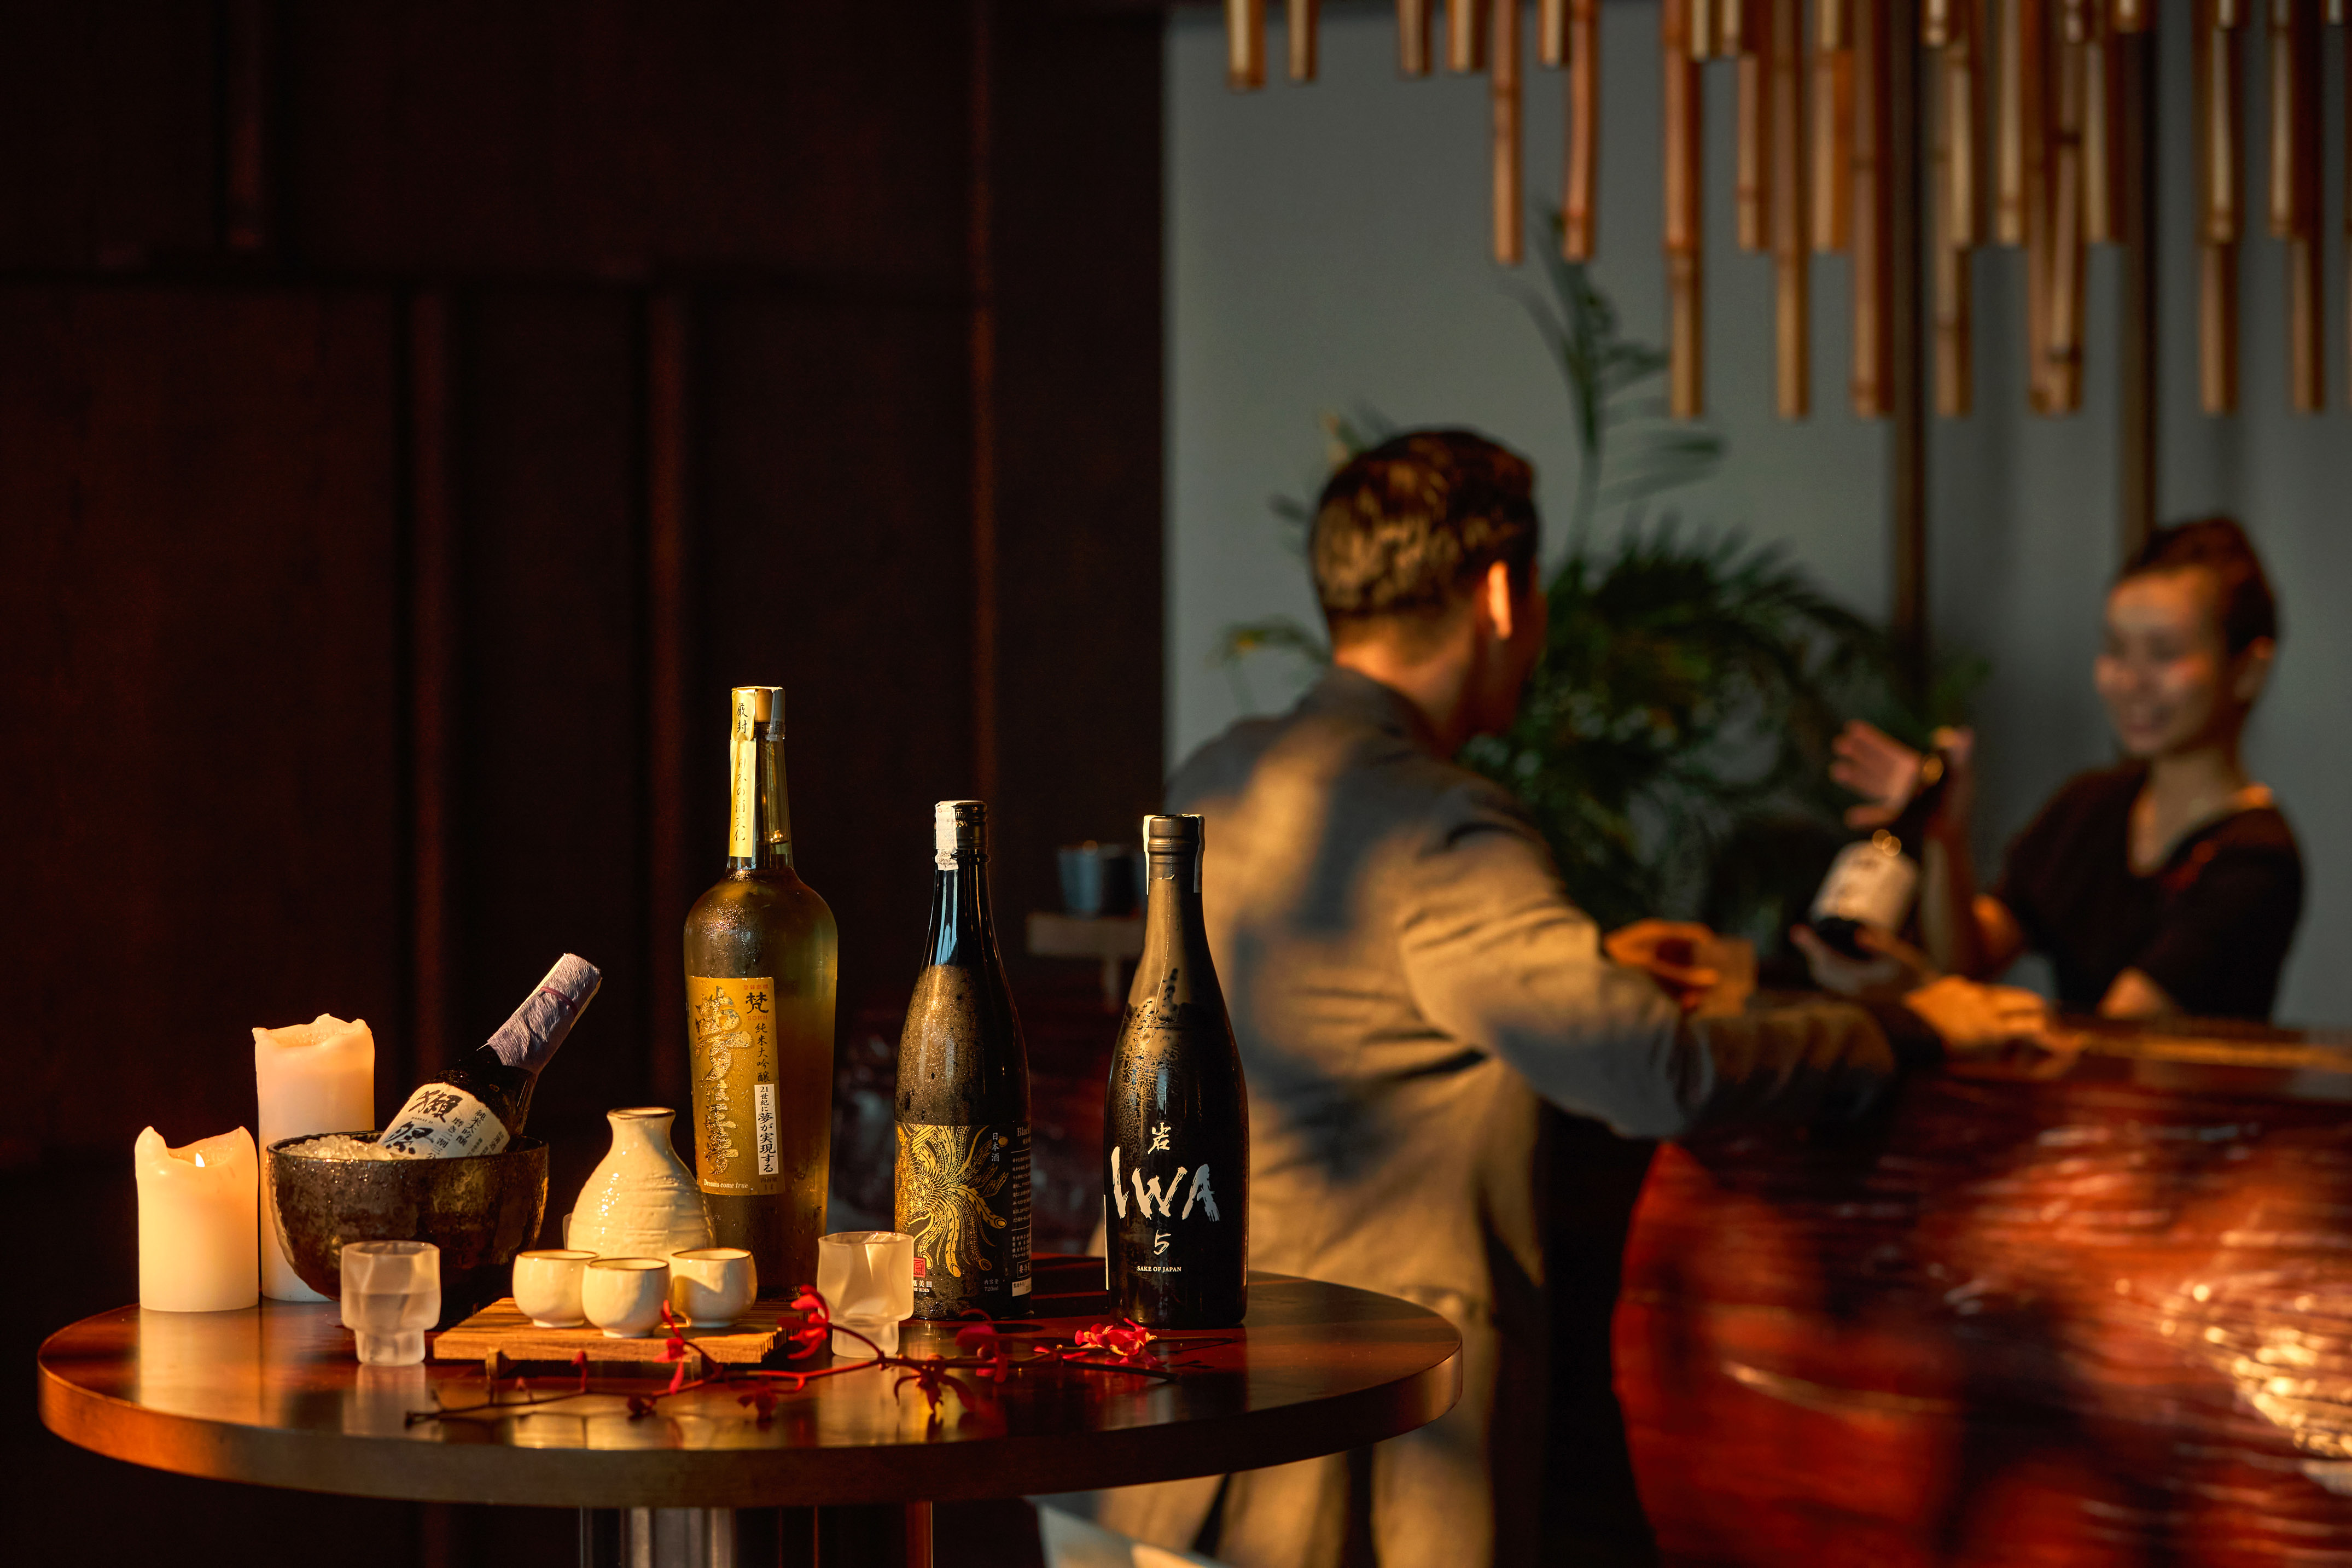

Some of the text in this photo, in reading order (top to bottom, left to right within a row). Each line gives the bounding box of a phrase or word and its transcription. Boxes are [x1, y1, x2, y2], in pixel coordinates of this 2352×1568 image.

[746, 992, 769, 1014] 梵
[755, 1023, 770, 1082] 純米大吟醸
[991, 1132, 1000, 1162] 日本酒
[1148, 1122, 1171, 1155] 岩
[703, 1179, 720, 1188] Dreams
[1111, 1146, 1220, 1222] IWA
[1154, 1229, 1171, 1255] 5
